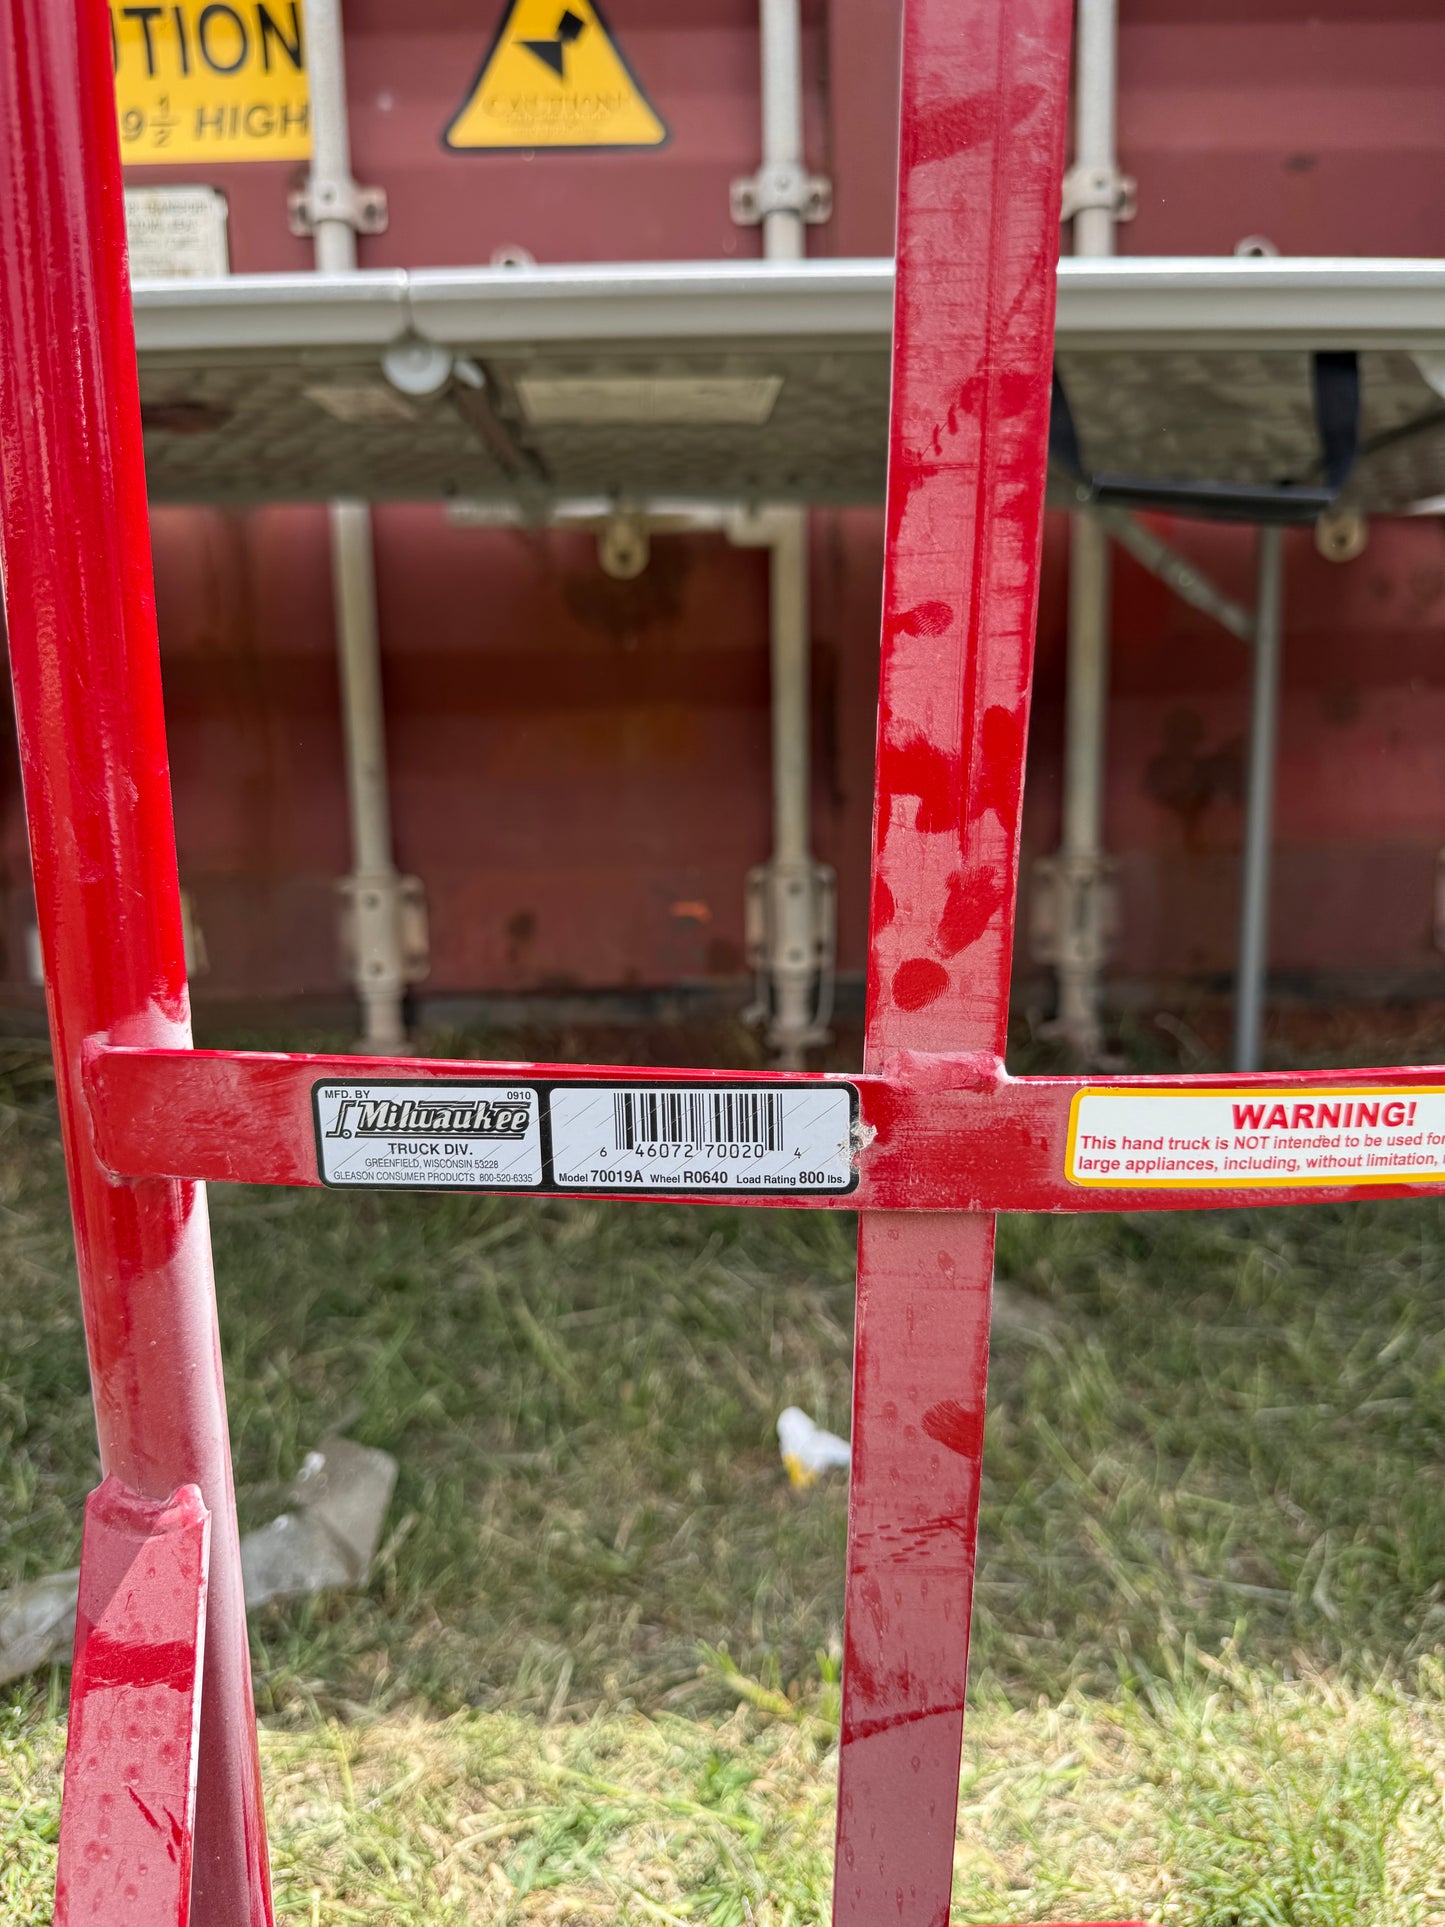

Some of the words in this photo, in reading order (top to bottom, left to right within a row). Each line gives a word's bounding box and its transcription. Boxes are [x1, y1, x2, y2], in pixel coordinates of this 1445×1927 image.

[110, 1, 304, 76] TION
[195, 104, 309, 140] HIGH
[325, 1090, 352, 1099] MFD.
[355, 1090, 370, 1099] BY
[507, 1091, 531, 1100] 0910
[357, 1100, 530, 1132] Milwaukee
[1232, 1101, 1418, 1130] WARNING!
[387, 1142, 440, 1156] TRUCK
[444, 1143, 473, 1156] DIV.
[1080, 1135, 1117, 1150] This
[1121, 1135, 1164, 1150] hand
[1168, 1136, 1211, 1150] truck
[1215, 1136, 1229, 1150] is
[1233, 1135, 1270, 1150] NOT
[1273, 1134, 1341, 1149] intended
[1345, 1134, 1360, 1148] to
[1364, 1133, 1383, 1147] be
[1387, 1131, 1423, 1146] used
[600, 1146, 608, 1158] 6
[635, 1143, 694, 1158] 46072
[705, 1144, 765, 1159] 70020
[793, 1147, 802, 1159] 4
[365, 1158, 422, 1169] GREENFIELD,
[423, 1159, 473, 1169] WISCONSIN
[474, 1159, 499, 1169] 53228
[1078, 1155, 1121, 1174] large
[1124, 1156, 1219, 1174] appliances,
[1223, 1155, 1301, 1173] including,
[1305, 1153, 1363, 1169] without
[1365, 1152, 1439, 1168] limitation,
[333, 1170, 375, 1181] GLEASON
[376, 1171, 426, 1181] CONSUMER
[427, 1172, 476, 1182] PRODUCTS
[479, 1173, 533, 1183] 800-520-6335
[558, 1173, 589, 1182] Model
[590, 1169, 644, 1183] 70019A
[649, 1174, 681, 1184] Wheel
[683, 1170, 728, 1184] R0640
[736, 1174, 762, 1184] Load
[763, 1174, 797, 1186] Rating
[799, 1171, 825, 1184] 800
[827, 1175, 846, 1184] lbs.
